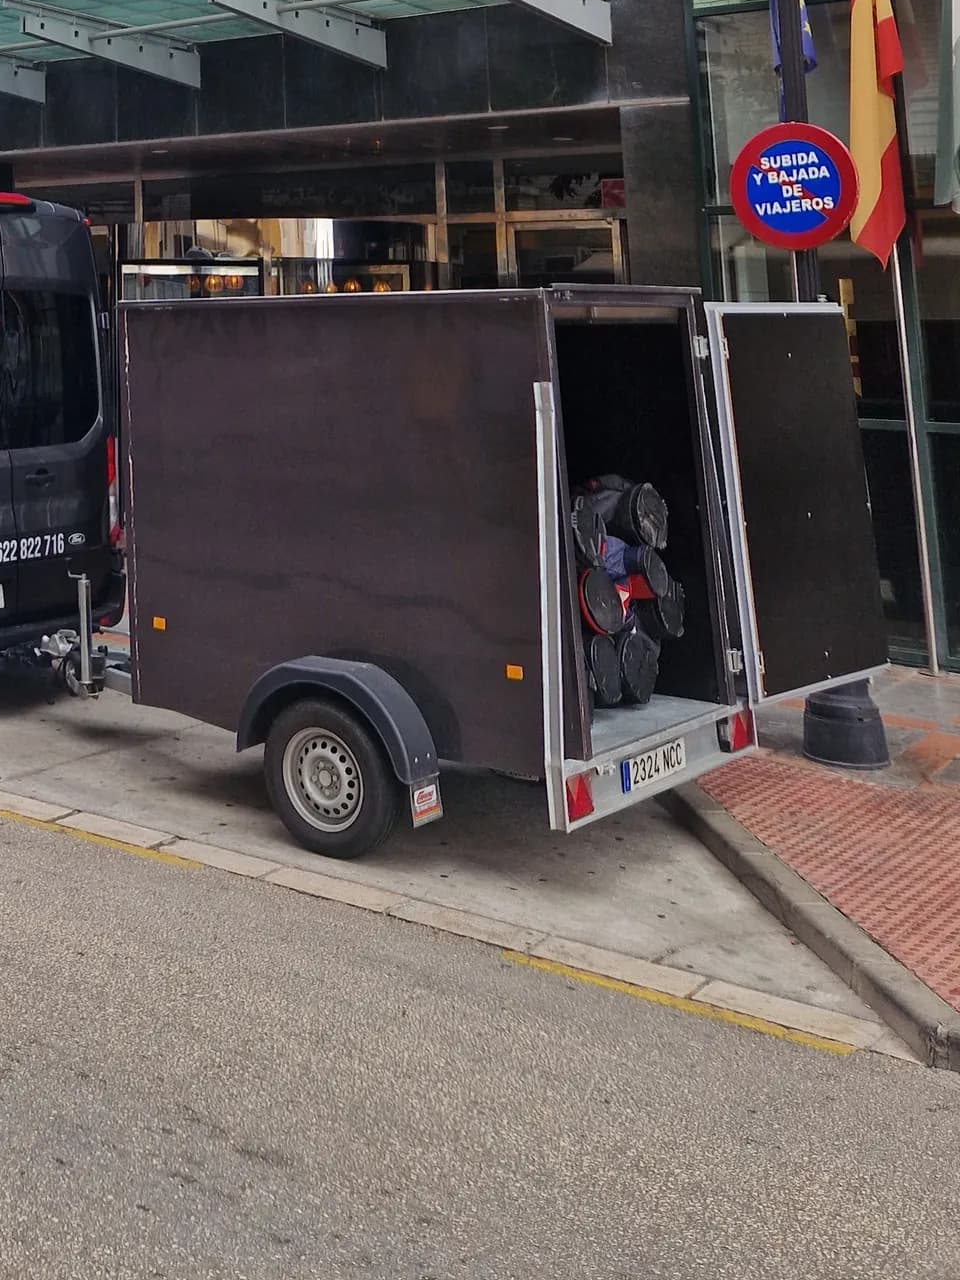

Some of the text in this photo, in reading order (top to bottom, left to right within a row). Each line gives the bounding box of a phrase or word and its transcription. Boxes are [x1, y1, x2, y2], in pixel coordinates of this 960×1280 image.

[760, 151, 819, 170] SUBIDA
[752, 166, 830, 186] Y BAJADA
[782, 184, 803, 198] DE
[755, 196, 834, 217] VIAJEROS
[20, 535, 41, 559] 822
[43, 533, 65, 555] 716
[632, 742, 682, 785] 2324 NCC
